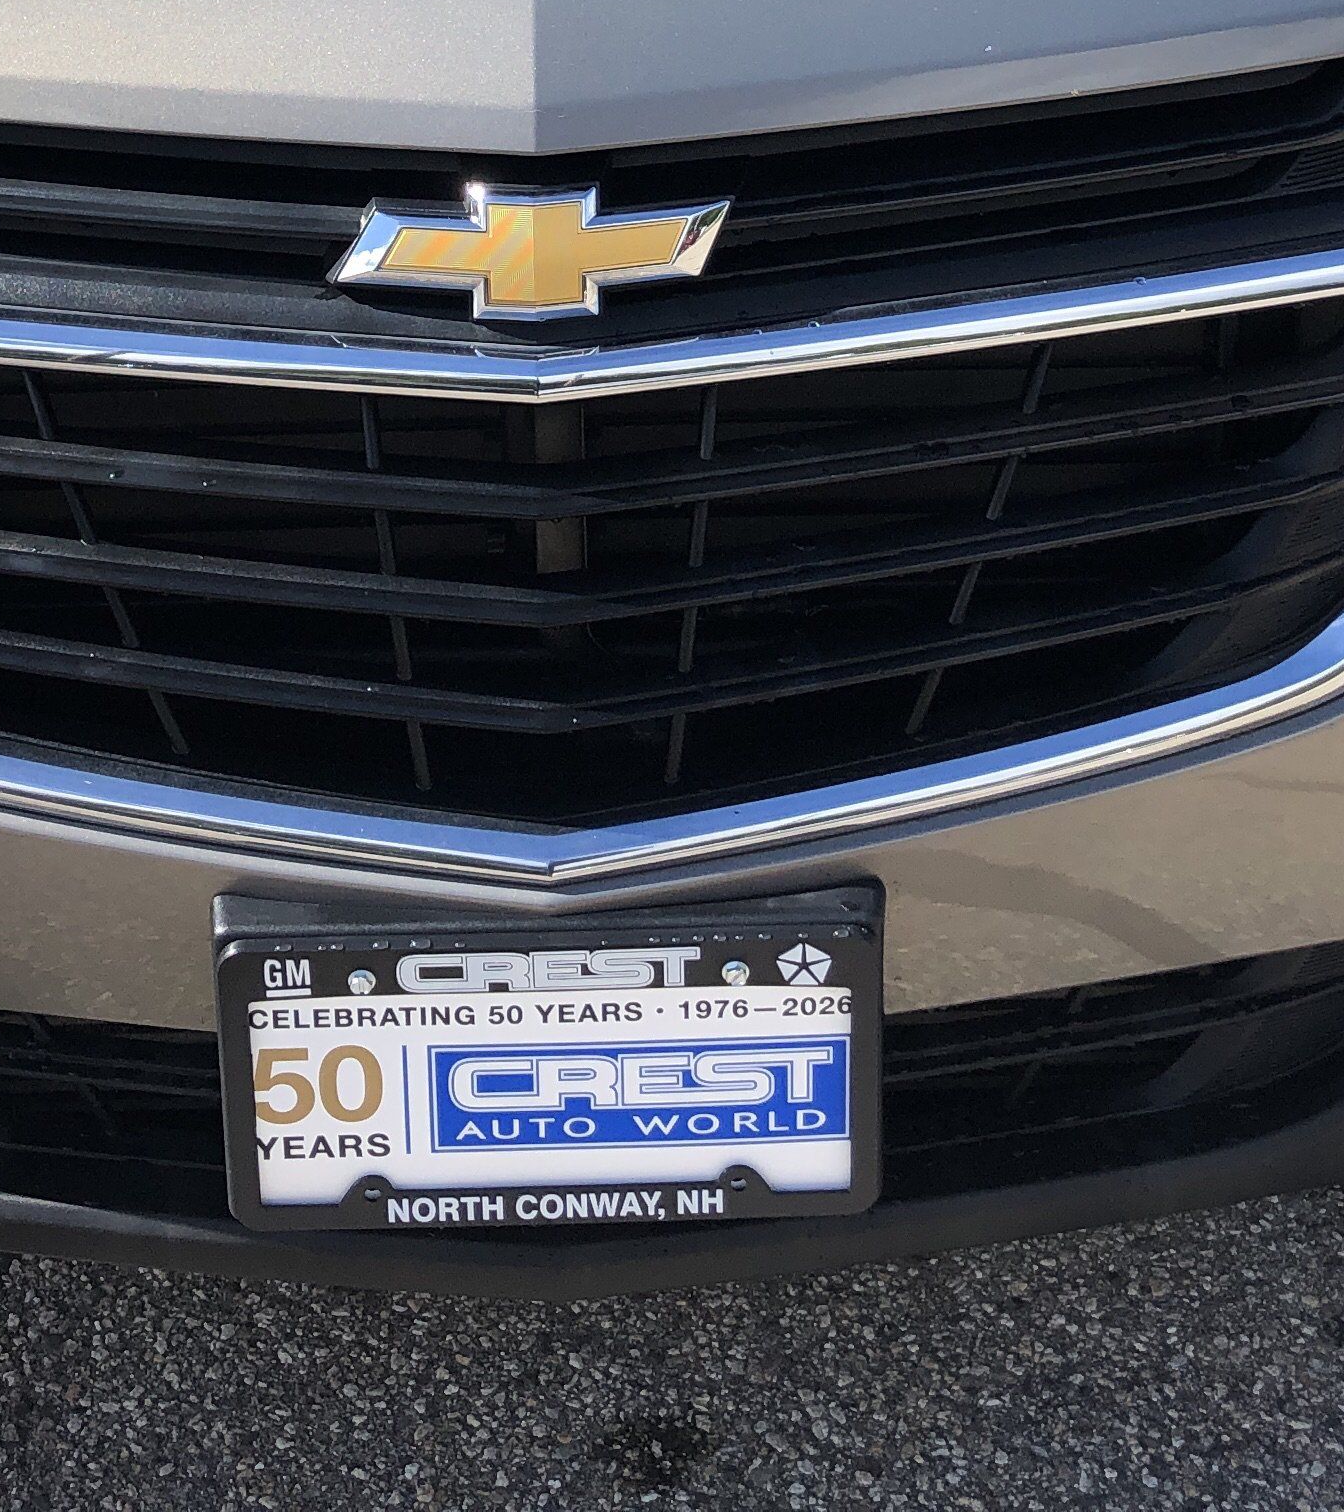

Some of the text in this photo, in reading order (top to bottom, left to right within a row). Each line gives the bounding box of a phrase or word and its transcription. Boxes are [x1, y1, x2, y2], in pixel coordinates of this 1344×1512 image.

[263, 959, 311, 988] GM
[396, 947, 701, 993] CREST
[249, 1004, 476, 1030] CELEBRATING
[488, 1004, 524, 1026] 50
[535, 1001, 643, 1025] YEARS
[254, 1044, 384, 1125] 50
[448, 1047, 833, 1112] CREST
[456, 1109, 827, 1140] AUTO WORLD
[256, 1133, 391, 1161] YEARS
[387, 1189, 724, 1223] NORTH CONWAY, NH
